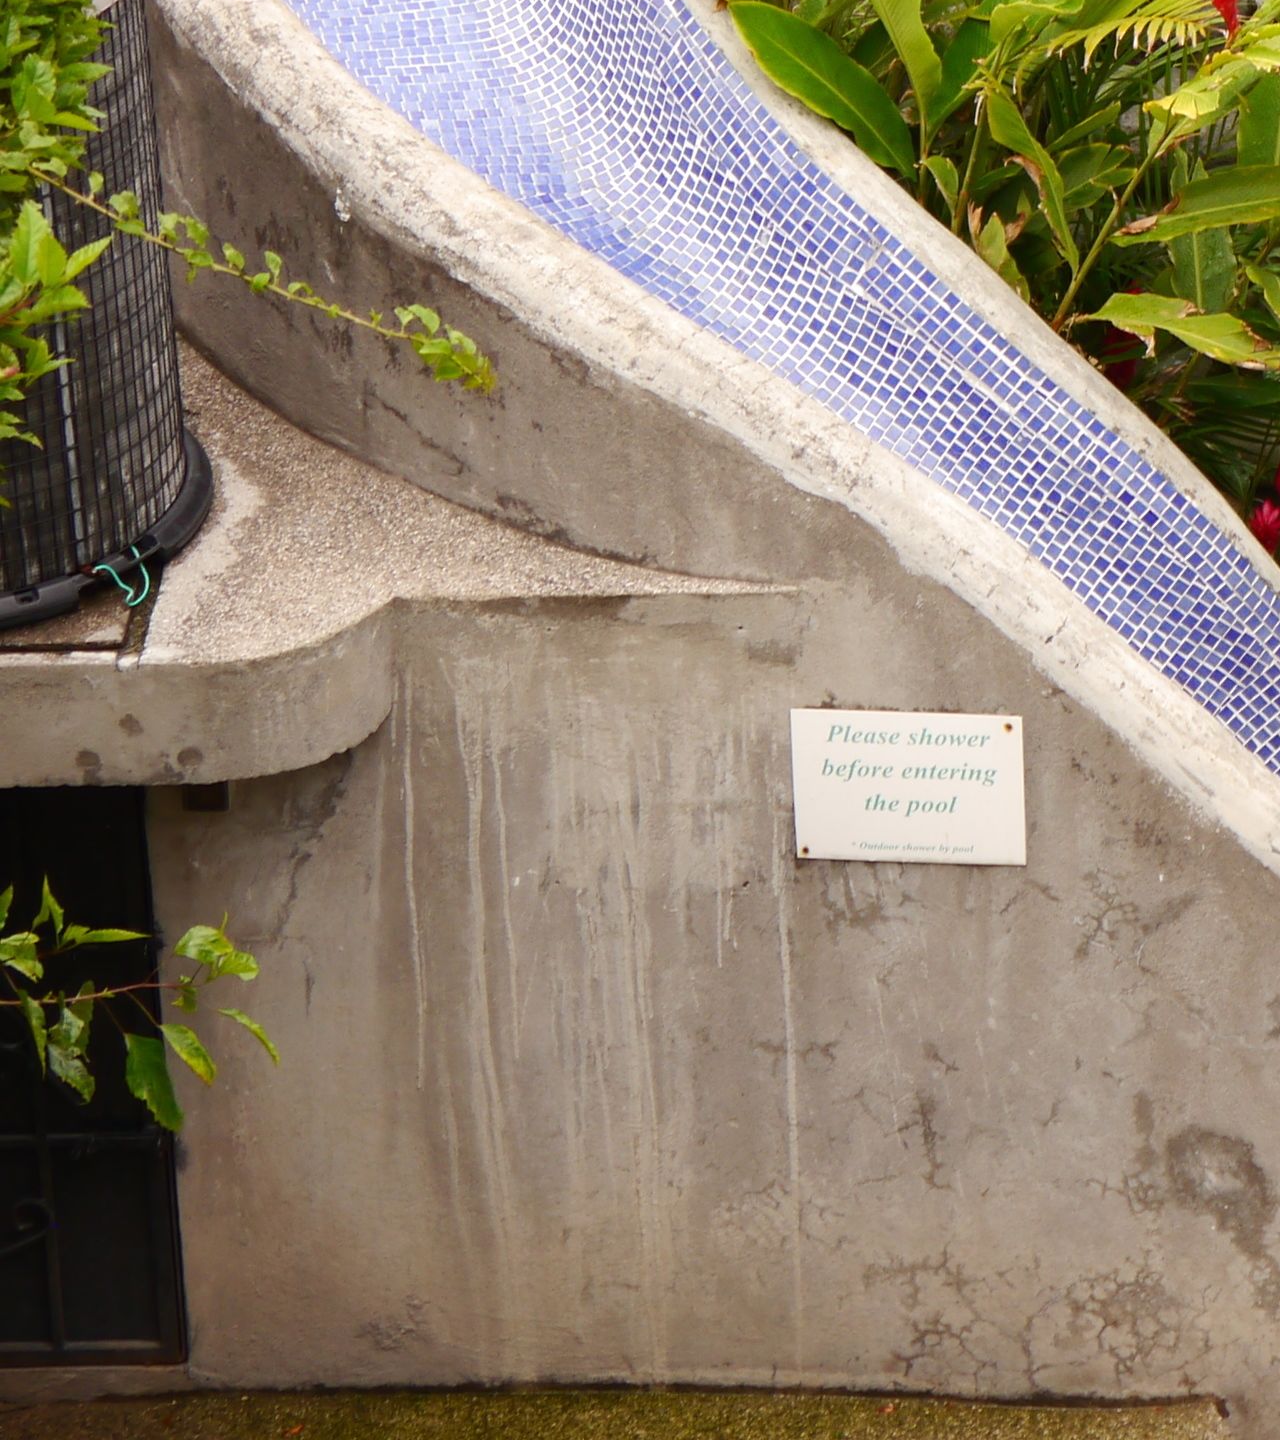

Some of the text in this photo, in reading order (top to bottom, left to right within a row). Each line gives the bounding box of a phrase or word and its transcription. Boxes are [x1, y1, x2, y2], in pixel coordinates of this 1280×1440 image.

[827, 725, 990, 747] Please shower
[821, 758, 997, 786] before entering
[864, 794, 957, 817] the pool
[859, 841, 975, 855] Outdoor shower by pool
